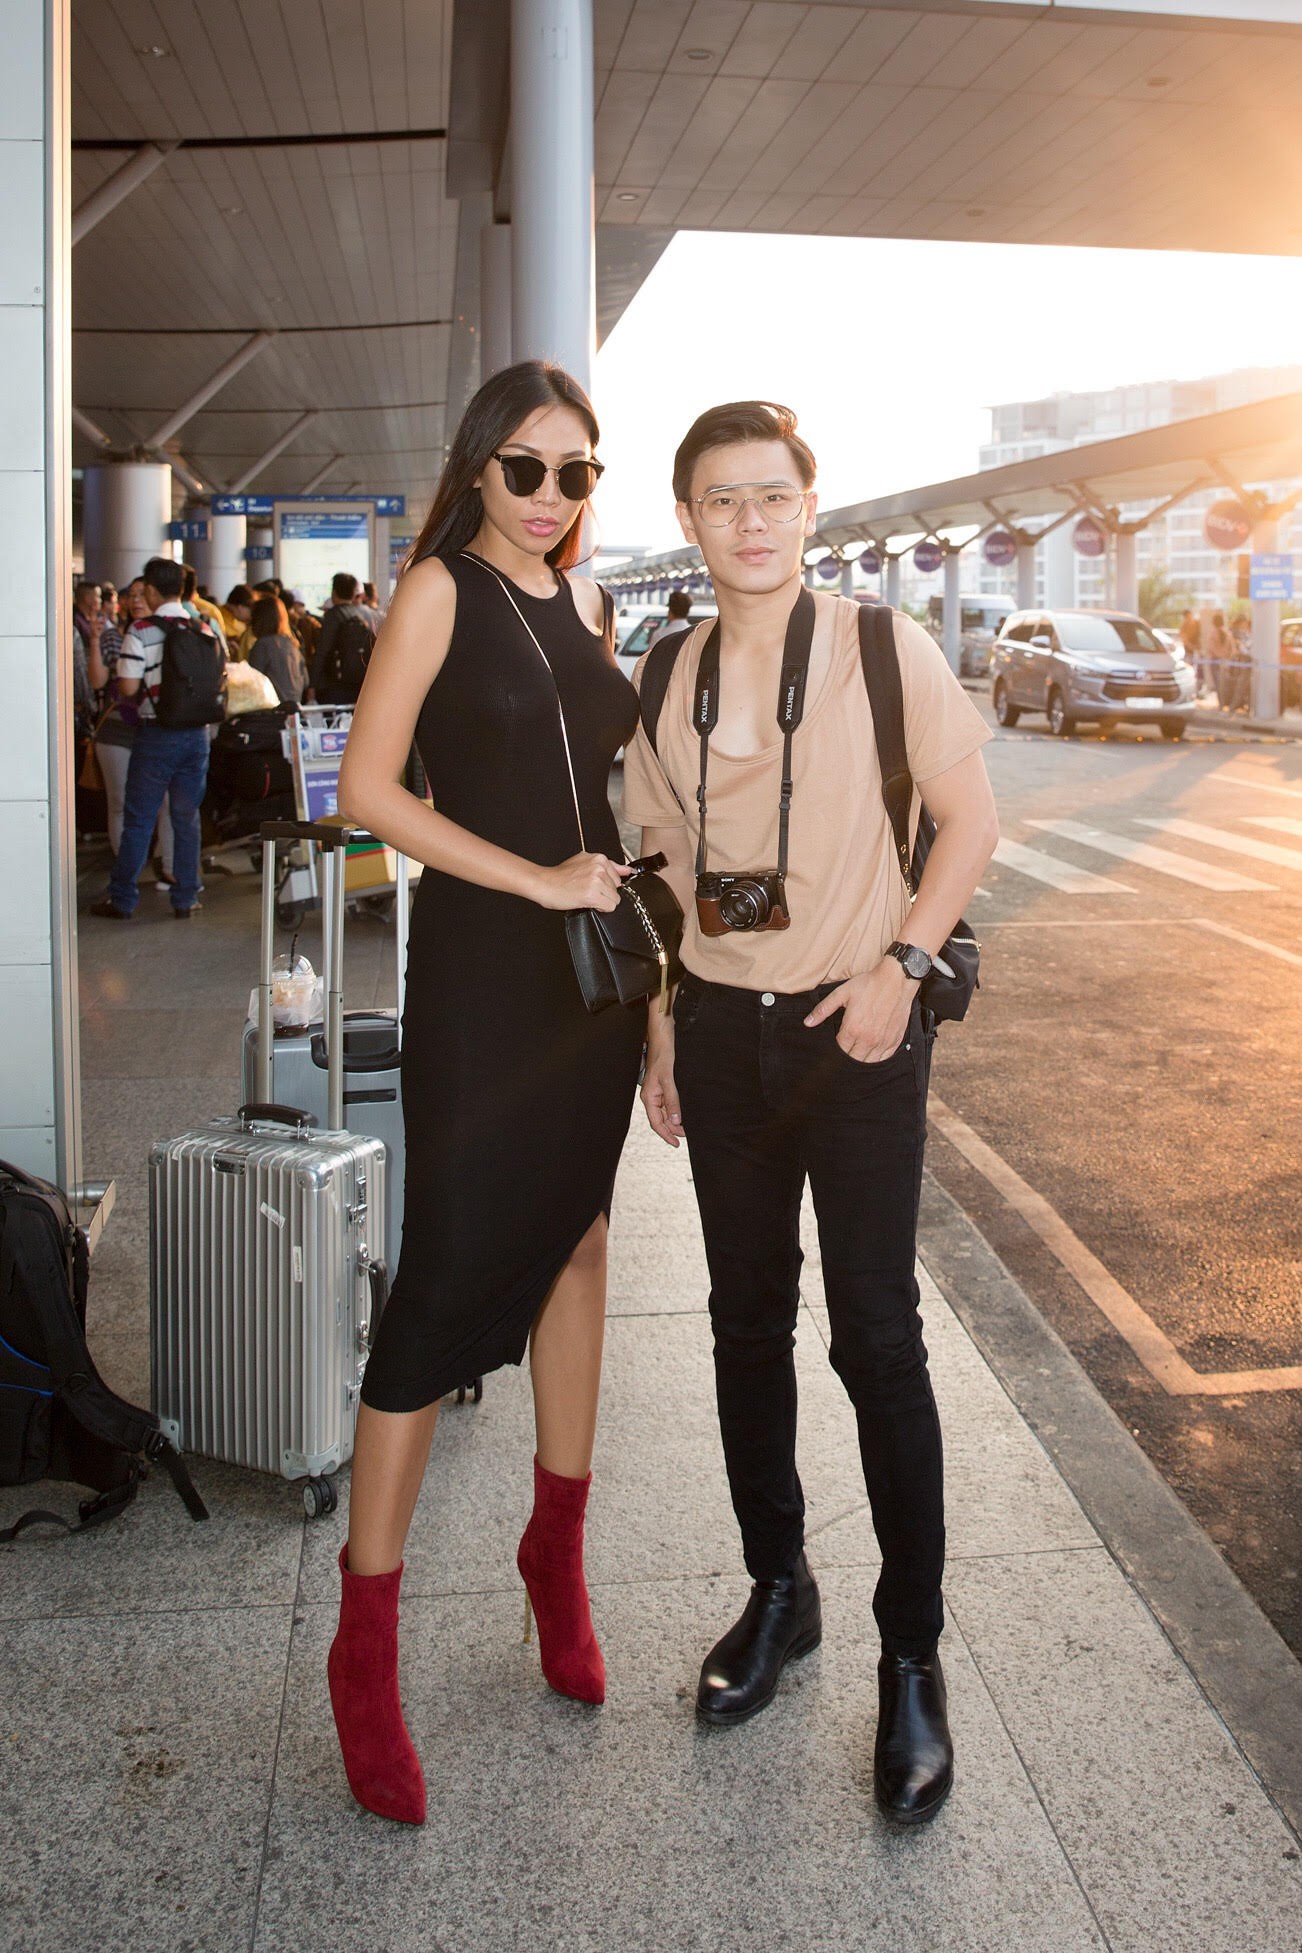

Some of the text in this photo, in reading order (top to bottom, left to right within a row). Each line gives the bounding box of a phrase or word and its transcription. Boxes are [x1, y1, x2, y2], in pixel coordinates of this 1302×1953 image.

[181, 523, 199, 539] 11
[701, 689, 709, 723] PENTAX
[785, 686, 795, 721] PENTAX
